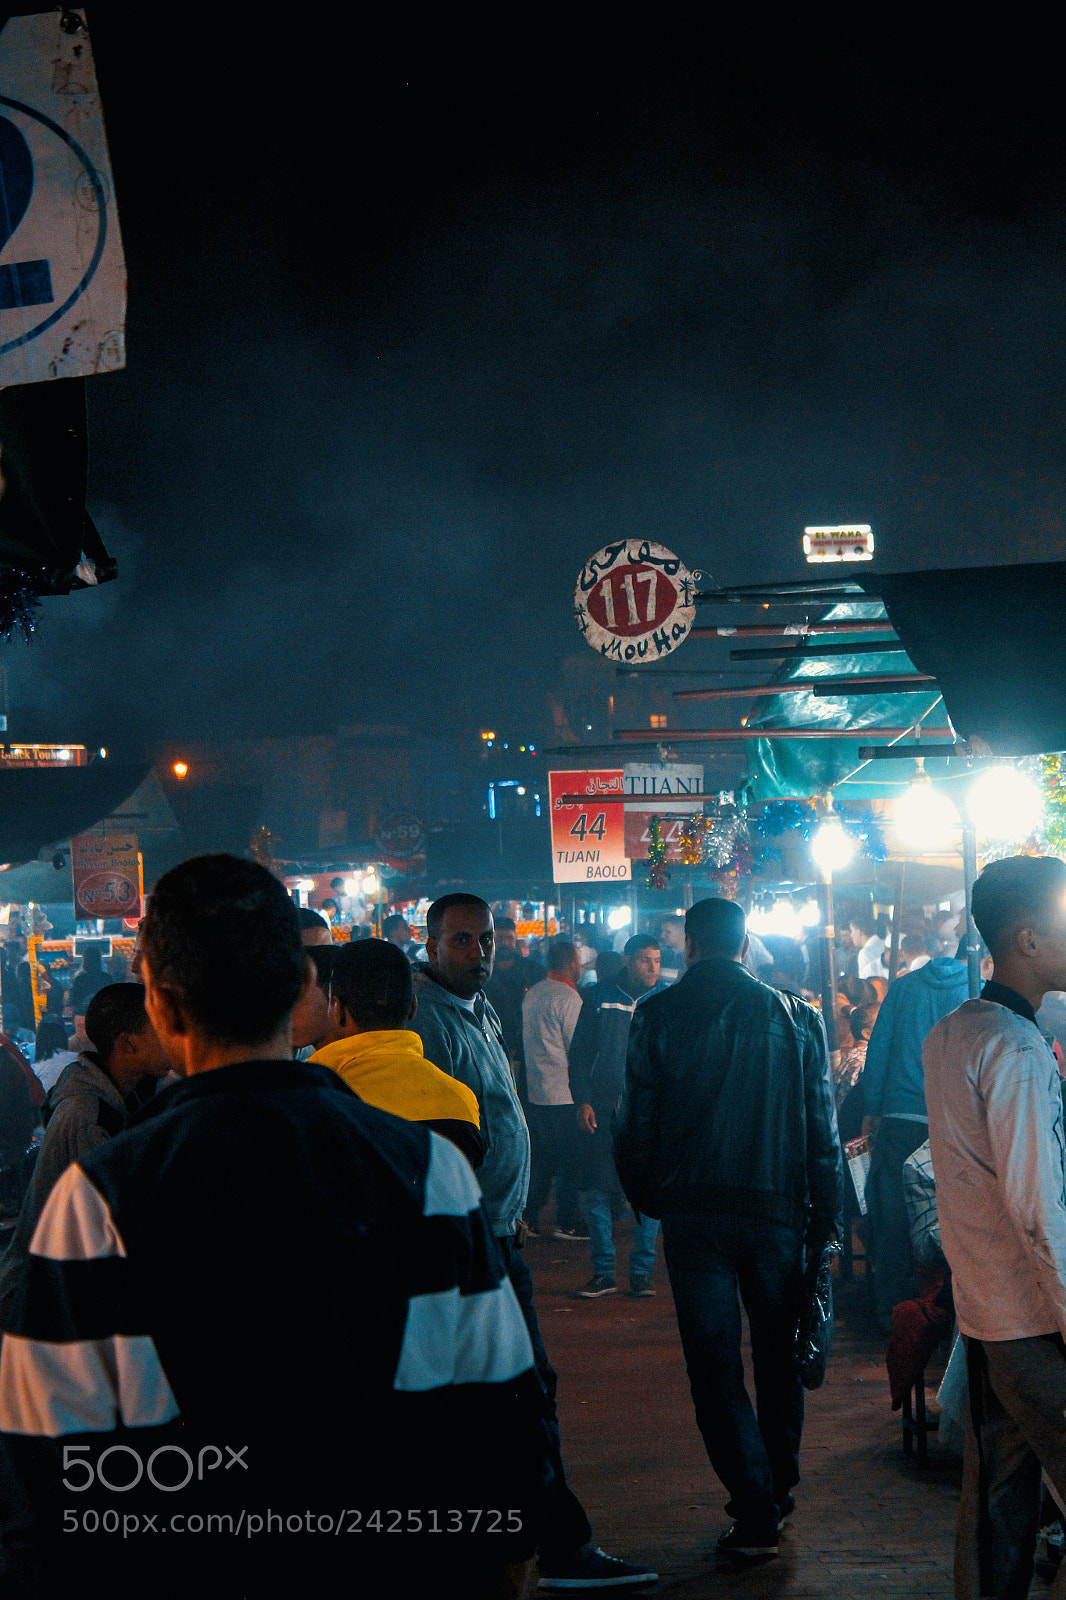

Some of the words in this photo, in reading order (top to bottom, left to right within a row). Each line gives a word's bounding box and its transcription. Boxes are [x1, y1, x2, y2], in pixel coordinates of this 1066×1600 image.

[600, 570, 657, 628] 117
[570, 813, 606, 842] 44
[557, 850, 600, 863] TIJANI
[586, 865, 627, 879] BAOLO
